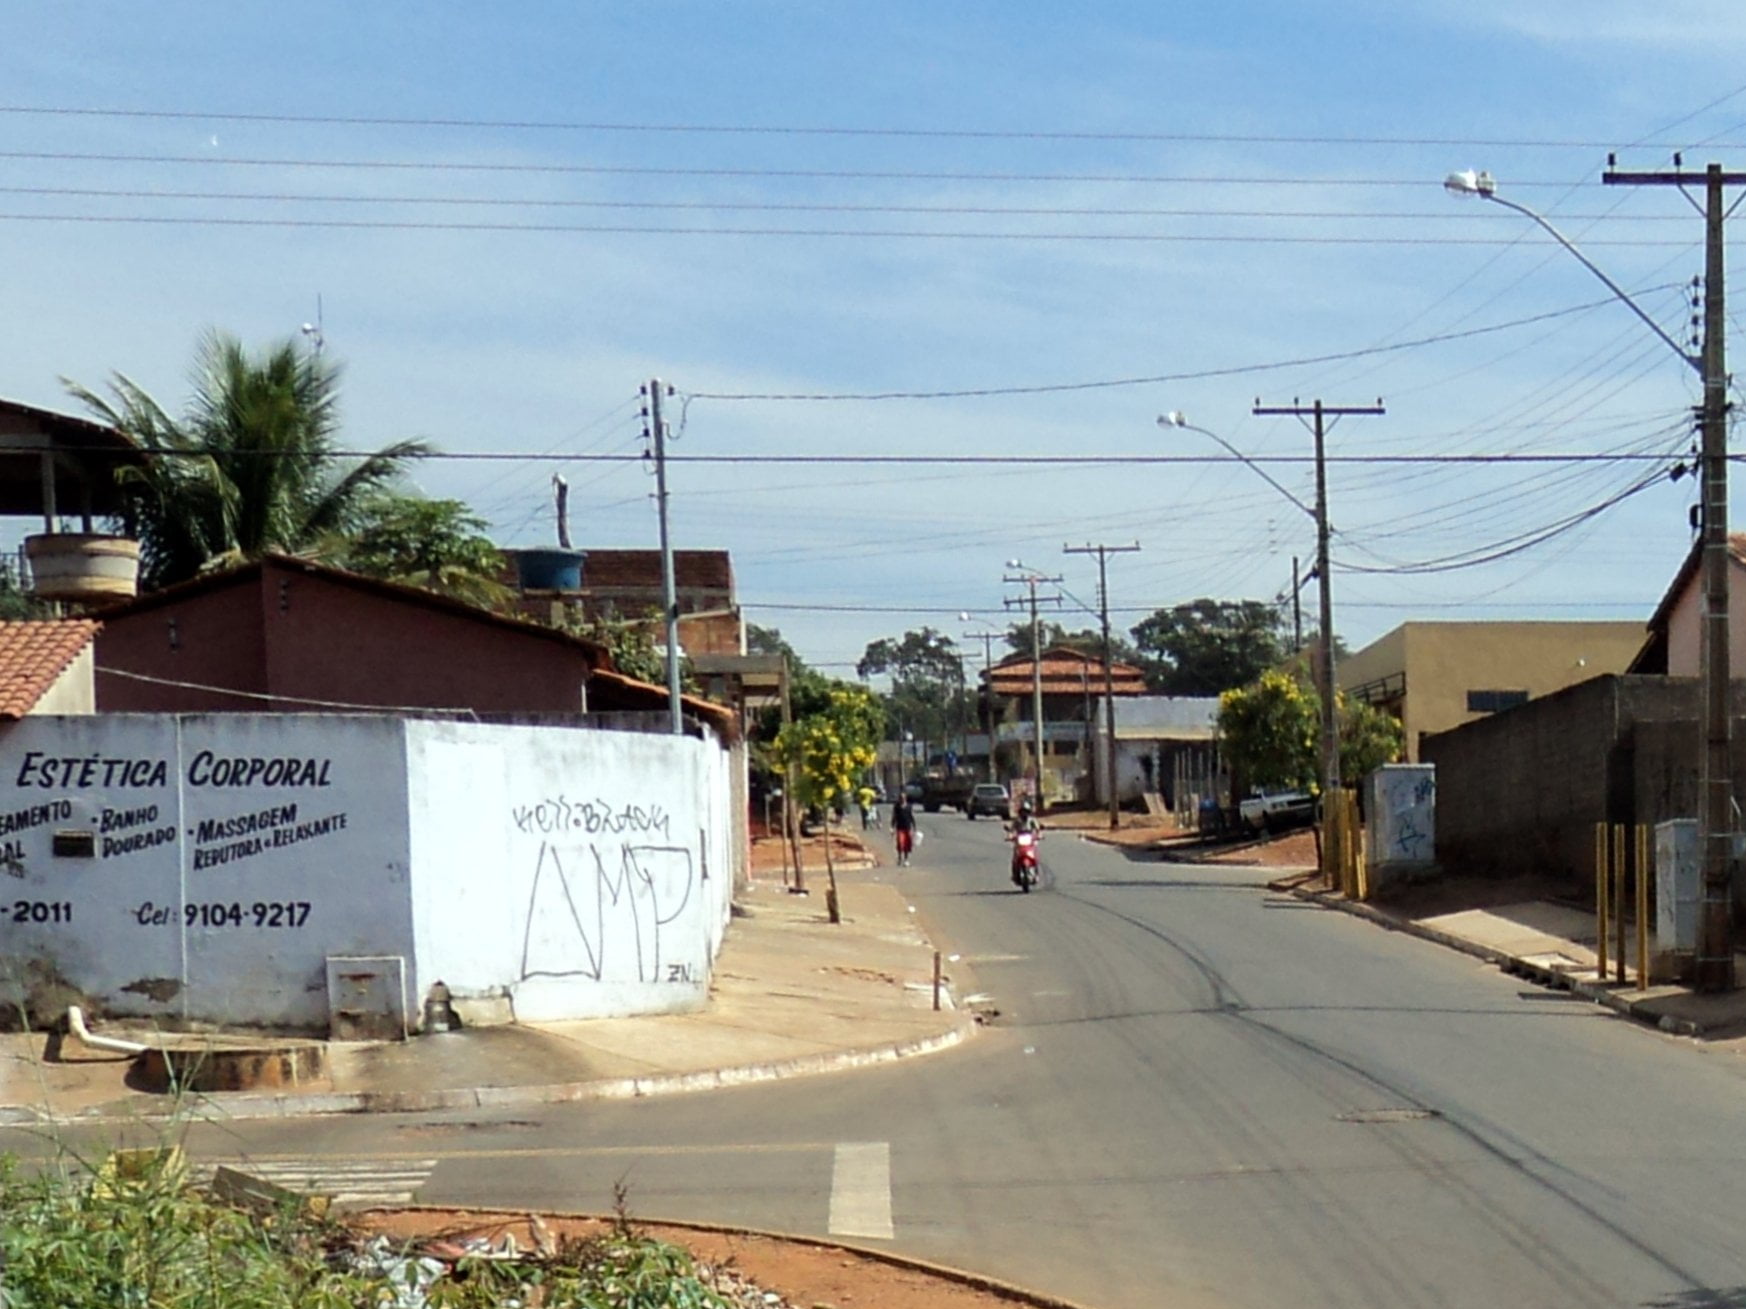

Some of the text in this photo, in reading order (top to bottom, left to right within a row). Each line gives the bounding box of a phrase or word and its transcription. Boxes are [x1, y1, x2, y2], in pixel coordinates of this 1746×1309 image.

[16, 750, 331, 788] ESTÉTICA CORPORAL
[100, 805, 158, 833] BANHO
[196, 803, 297, 845] MASSAGEM
[103, 827, 175, 858] DOURADO
[193, 838, 262, 871] REDUTORA
[273, 813, 347, 848] RELAXANTE
